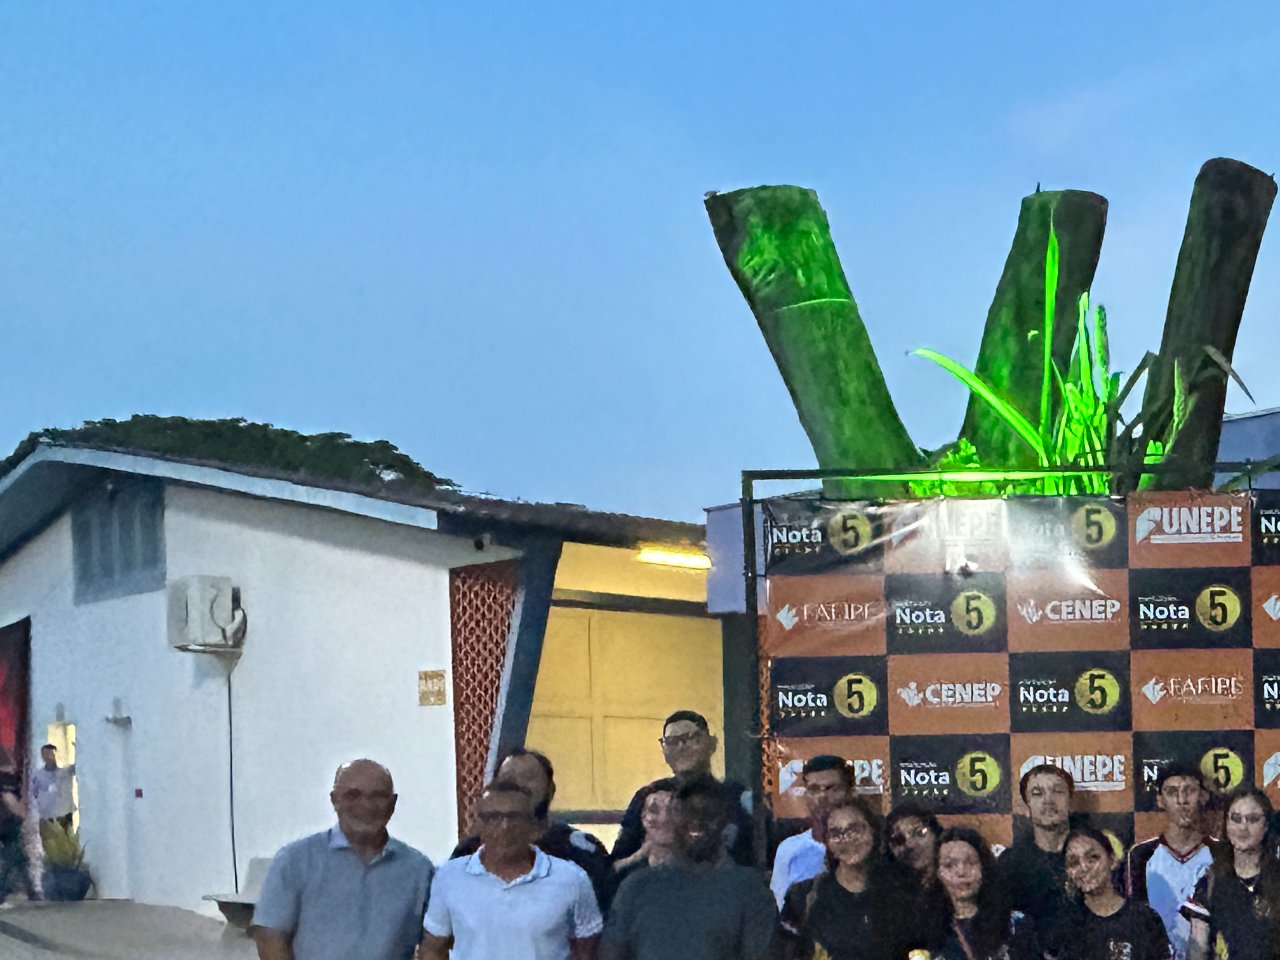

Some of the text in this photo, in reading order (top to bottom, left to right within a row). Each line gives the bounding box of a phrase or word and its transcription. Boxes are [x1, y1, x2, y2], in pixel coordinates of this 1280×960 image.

[772, 527, 822, 544] Nota
[895, 607, 946, 624] Nota
[1044, 599, 1122, 621] CENEP
[1139, 603, 1190, 620] Nota
[777, 691, 828, 708] Nota
[925, 681, 1001, 704] CENEP
[1018, 686, 1070, 703] Nota
[900, 768, 950, 785] Nota
